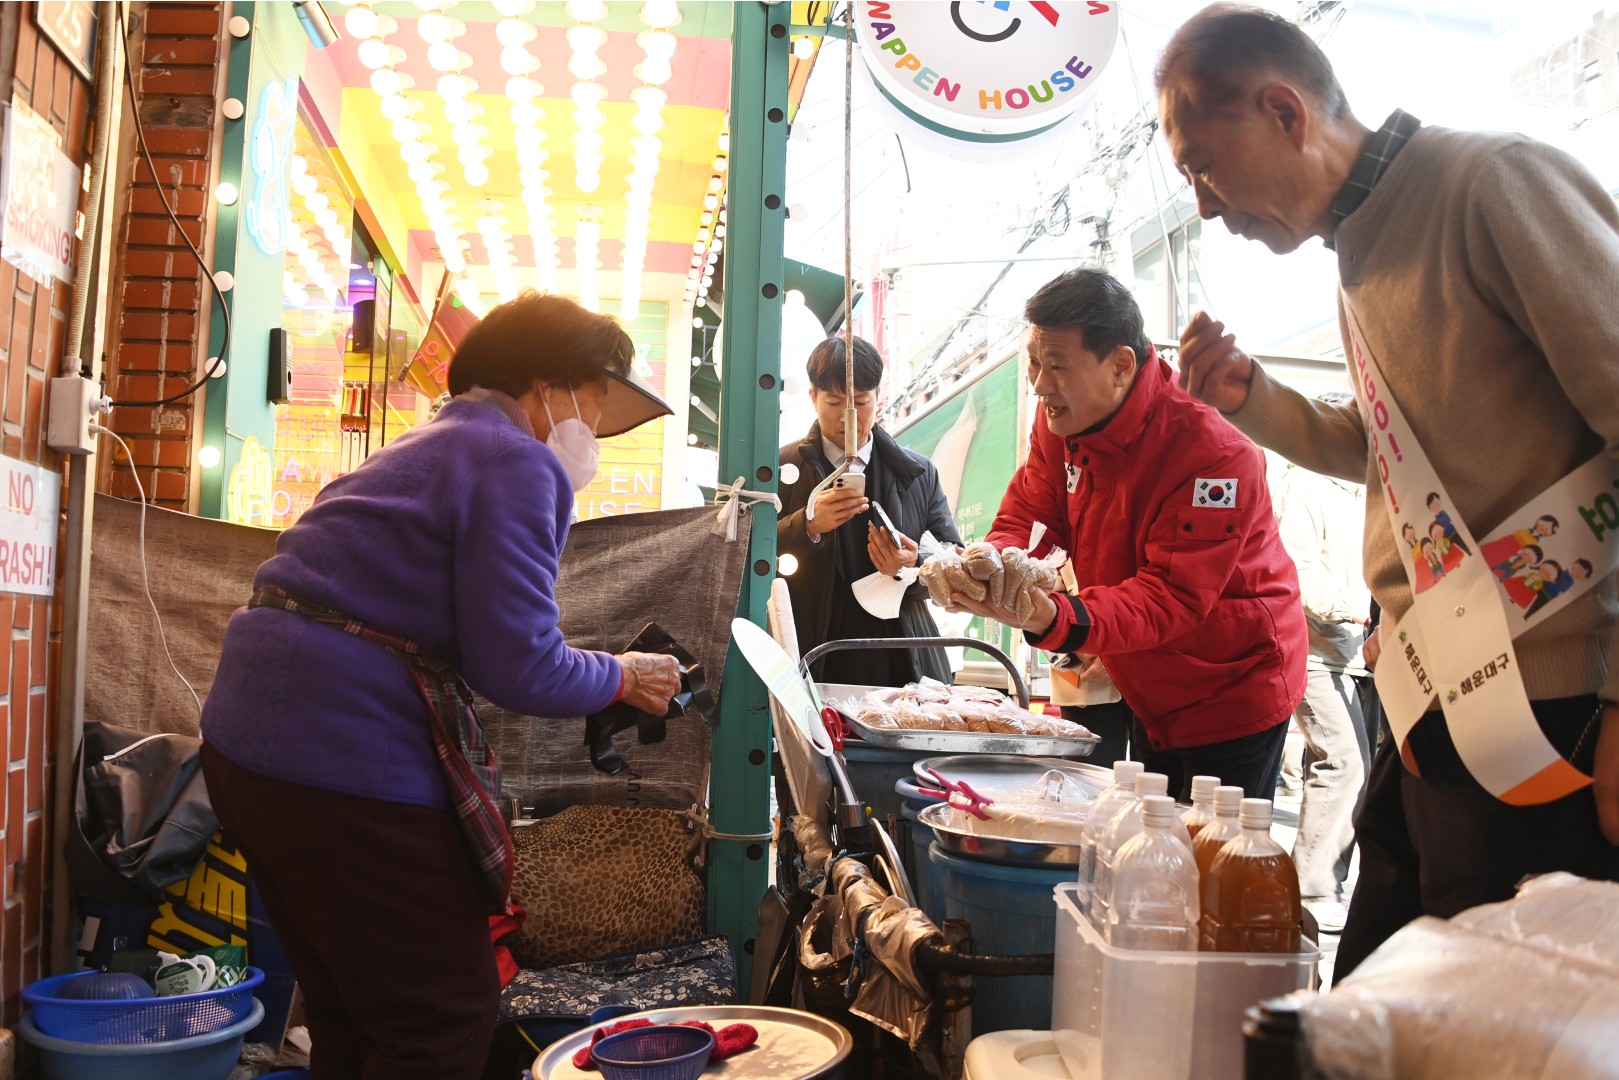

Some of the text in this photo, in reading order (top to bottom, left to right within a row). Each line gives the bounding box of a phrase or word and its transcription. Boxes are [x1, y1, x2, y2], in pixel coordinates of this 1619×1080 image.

[866, 0, 1093, 110] WAPPEN HOUSE
[7, 207, 74, 269] SMOKING!
[8, 469, 34, 516] NO
[587, 469, 653, 495] PEN
[0, 538, 52, 587] RASH!
[1404, 642, 1433, 696] 해운대구
[1459, 652, 1511, 696] 해운대구
